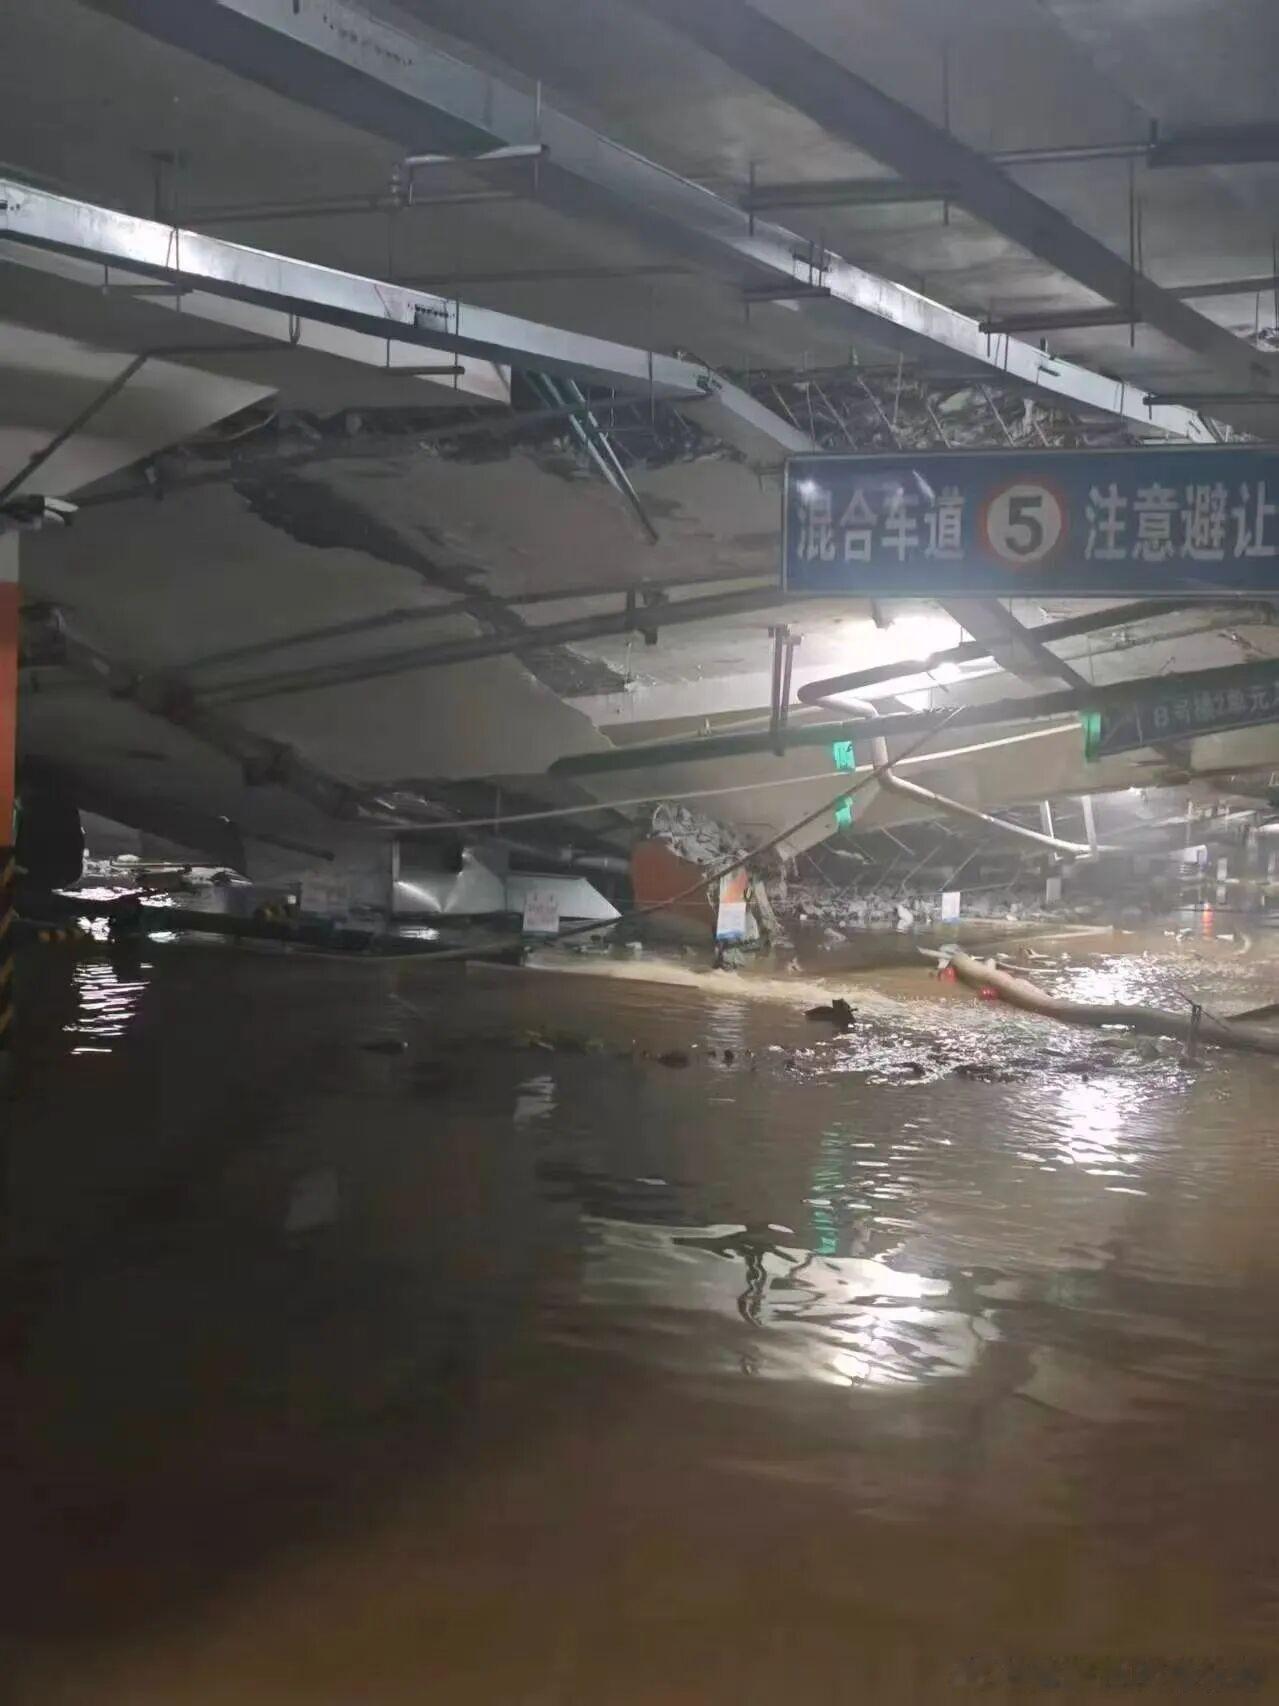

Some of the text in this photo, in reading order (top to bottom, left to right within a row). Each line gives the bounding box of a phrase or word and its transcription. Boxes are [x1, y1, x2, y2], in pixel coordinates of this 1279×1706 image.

[797, 481, 1279, 562] 混合车道 5 注意避让
